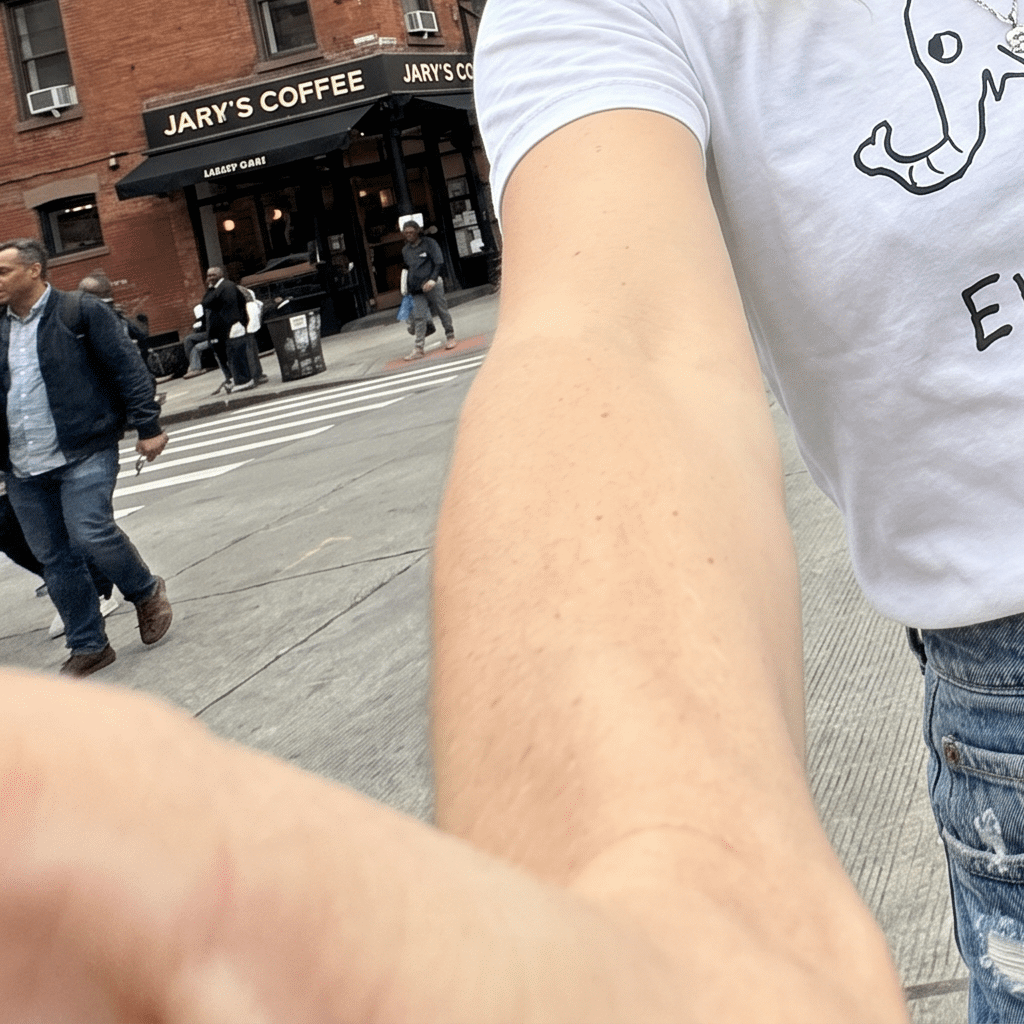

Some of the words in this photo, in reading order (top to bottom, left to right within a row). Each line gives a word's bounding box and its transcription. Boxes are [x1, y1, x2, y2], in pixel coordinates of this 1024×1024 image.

[403, 62, 454, 83] JARY'S
[165, 96, 254, 137] JARY'S
[260, 70, 365, 113] COFFEE
